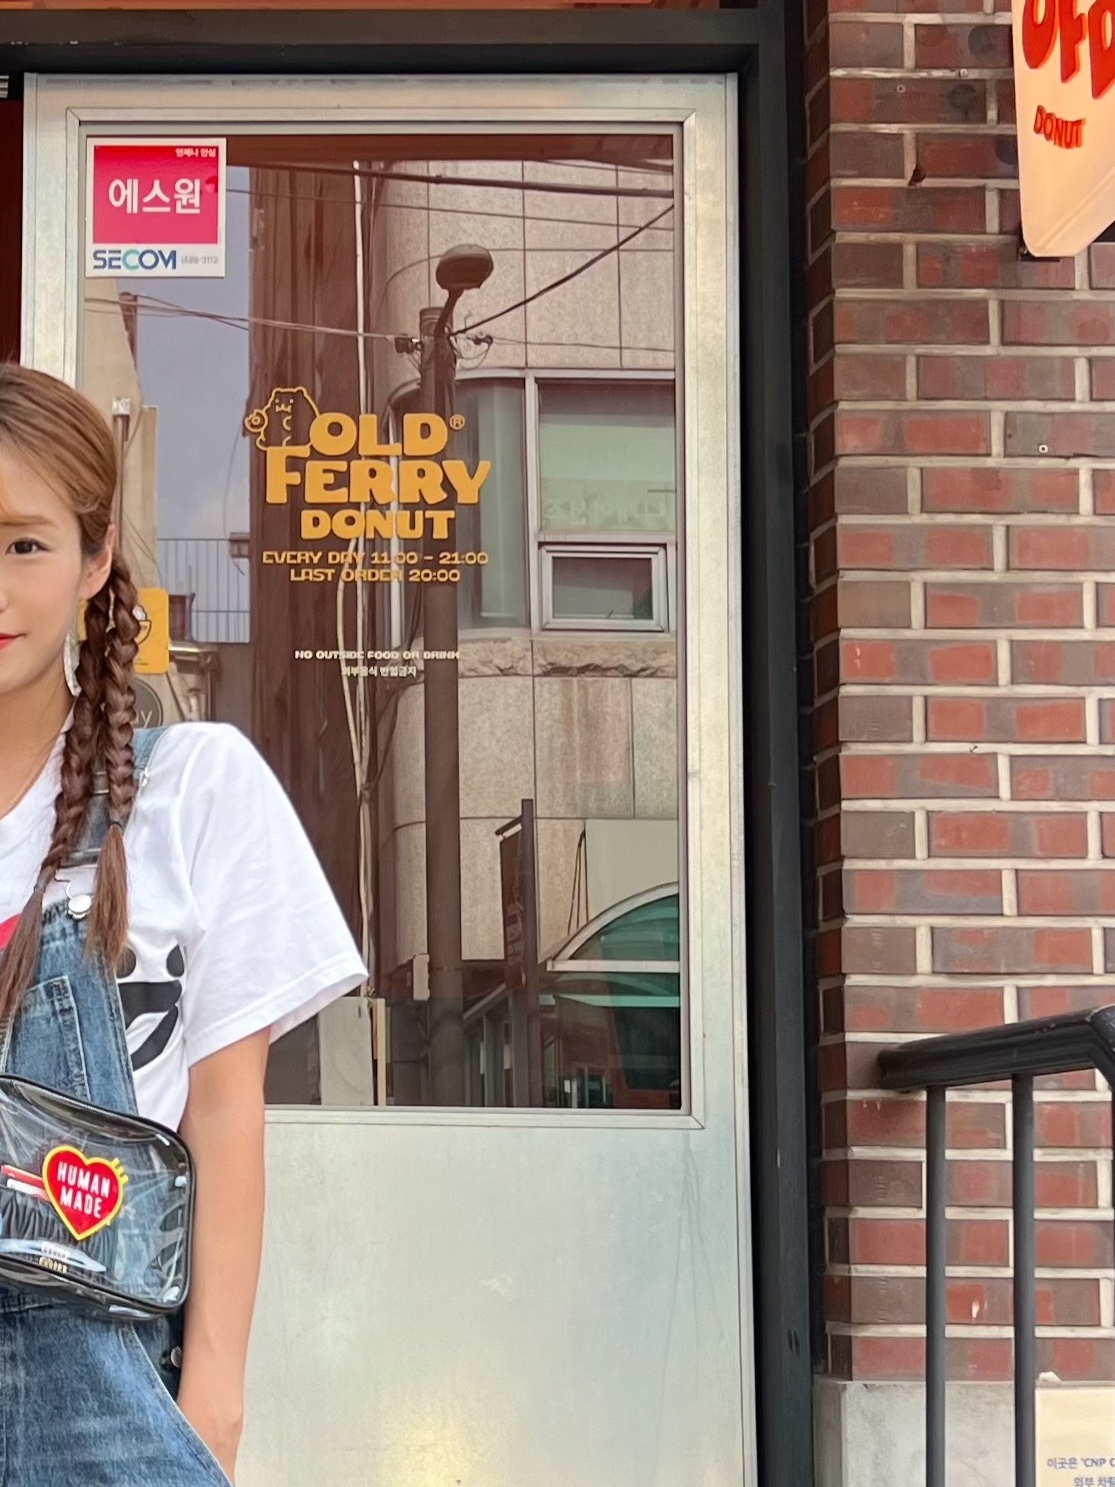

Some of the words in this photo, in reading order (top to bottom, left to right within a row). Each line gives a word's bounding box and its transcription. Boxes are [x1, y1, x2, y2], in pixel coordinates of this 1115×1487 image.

[1034, 105, 1086, 149] DONUT
[108, 178, 201, 214] 에스원
[92, 249, 177, 270] SECOM
[309, 412, 449, 456] OLD
[265, 445, 492, 505] FERRY
[300, 509, 456, 540] DONUT
[262, 551, 323, 564] EVERY
[327, 551, 365, 564] DAY
[370, 551, 418, 564] 1100
[438, 551, 489, 564] 21:00
[290, 568, 336, 582] LAST
[340, 568, 404, 582] ORDER
[408, 568, 461, 582] 20:00
[294, 650, 313, 660] NO
[315, 650, 365, 660] OUTSIDE
[367, 650, 400, 660] FOOD
[402, 650, 420, 660] OR
[423, 650, 460, 660] DRINK
[57, 1160, 111, 1199] HUMAN
[59, 1185, 102, 1219] MADE
[1047, 1457, 1078, 1469] 이곳은
